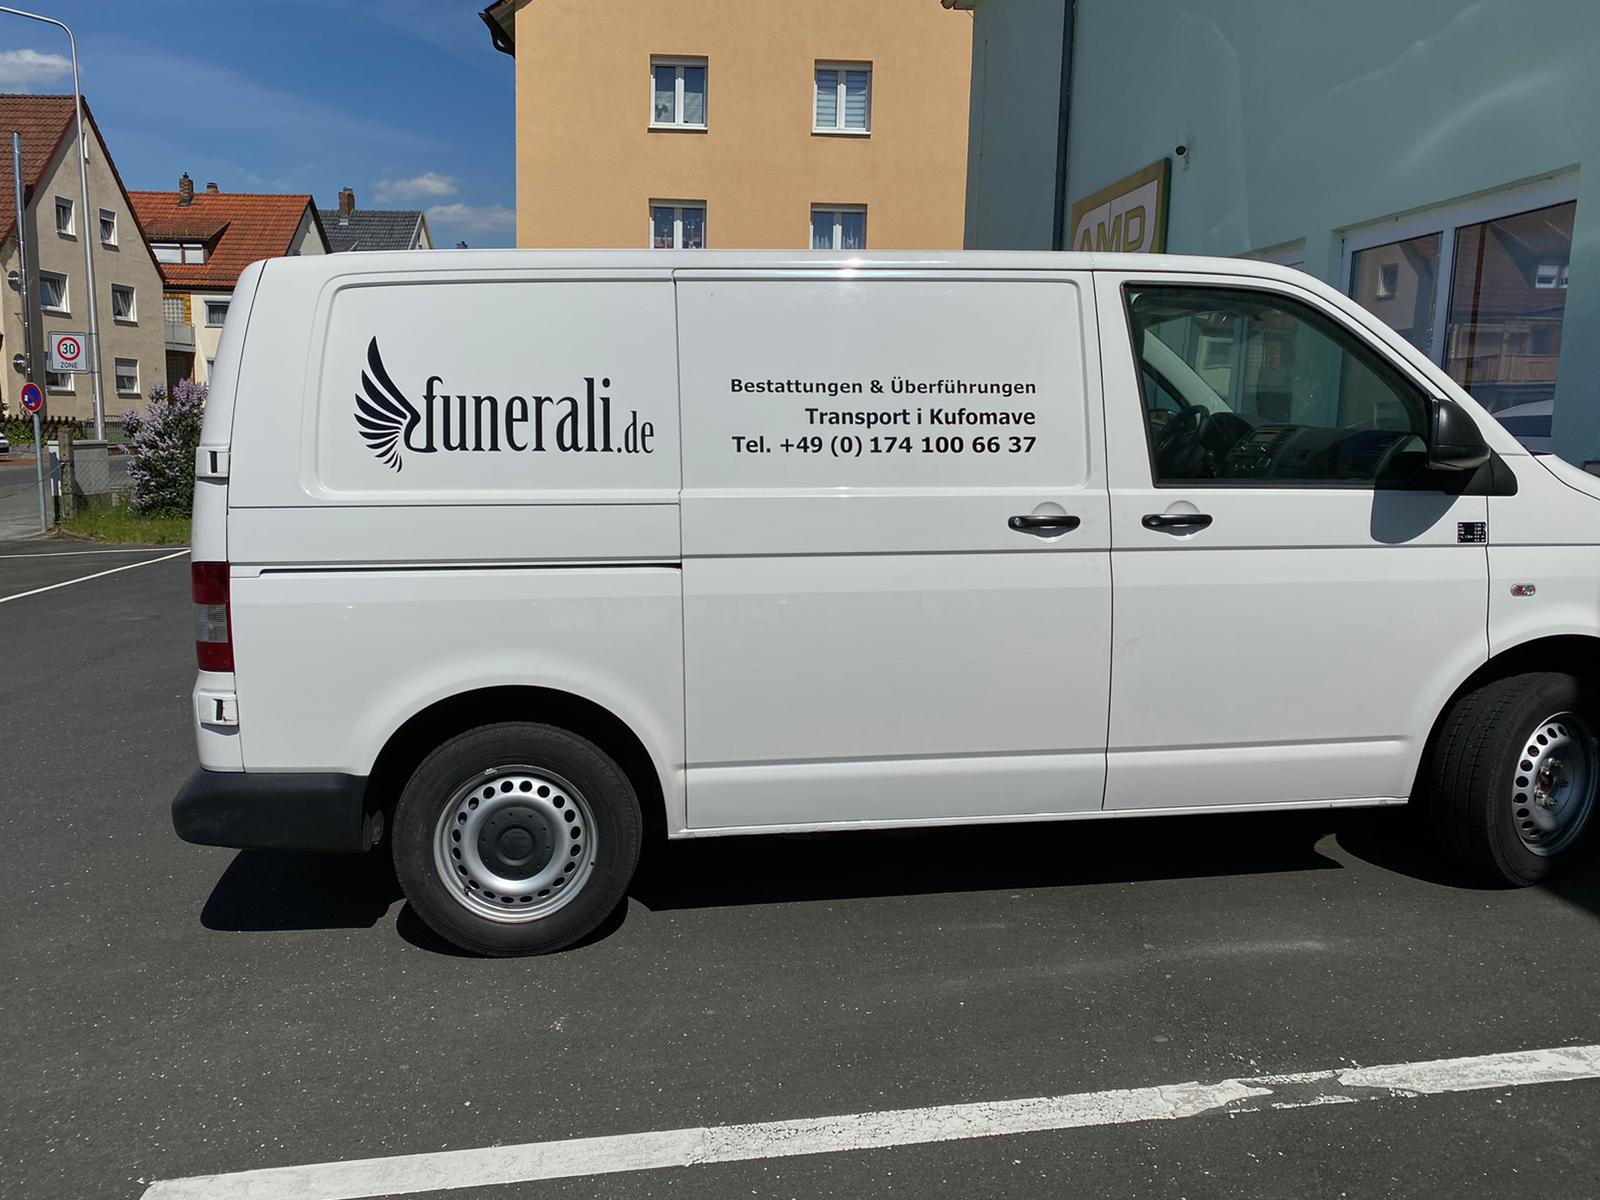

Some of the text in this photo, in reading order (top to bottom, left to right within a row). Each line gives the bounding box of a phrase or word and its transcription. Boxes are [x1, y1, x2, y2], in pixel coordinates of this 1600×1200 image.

[61, 343, 76, 355] 30
[731, 377, 1035, 397] Bestattungen & Überführungen
[421, 376, 654, 453] funerali.de
[805, 408, 1035, 429] Transport i Kufomave
[732, 436, 1036, 457] Tel. +49 (0) 174 100 66 37
